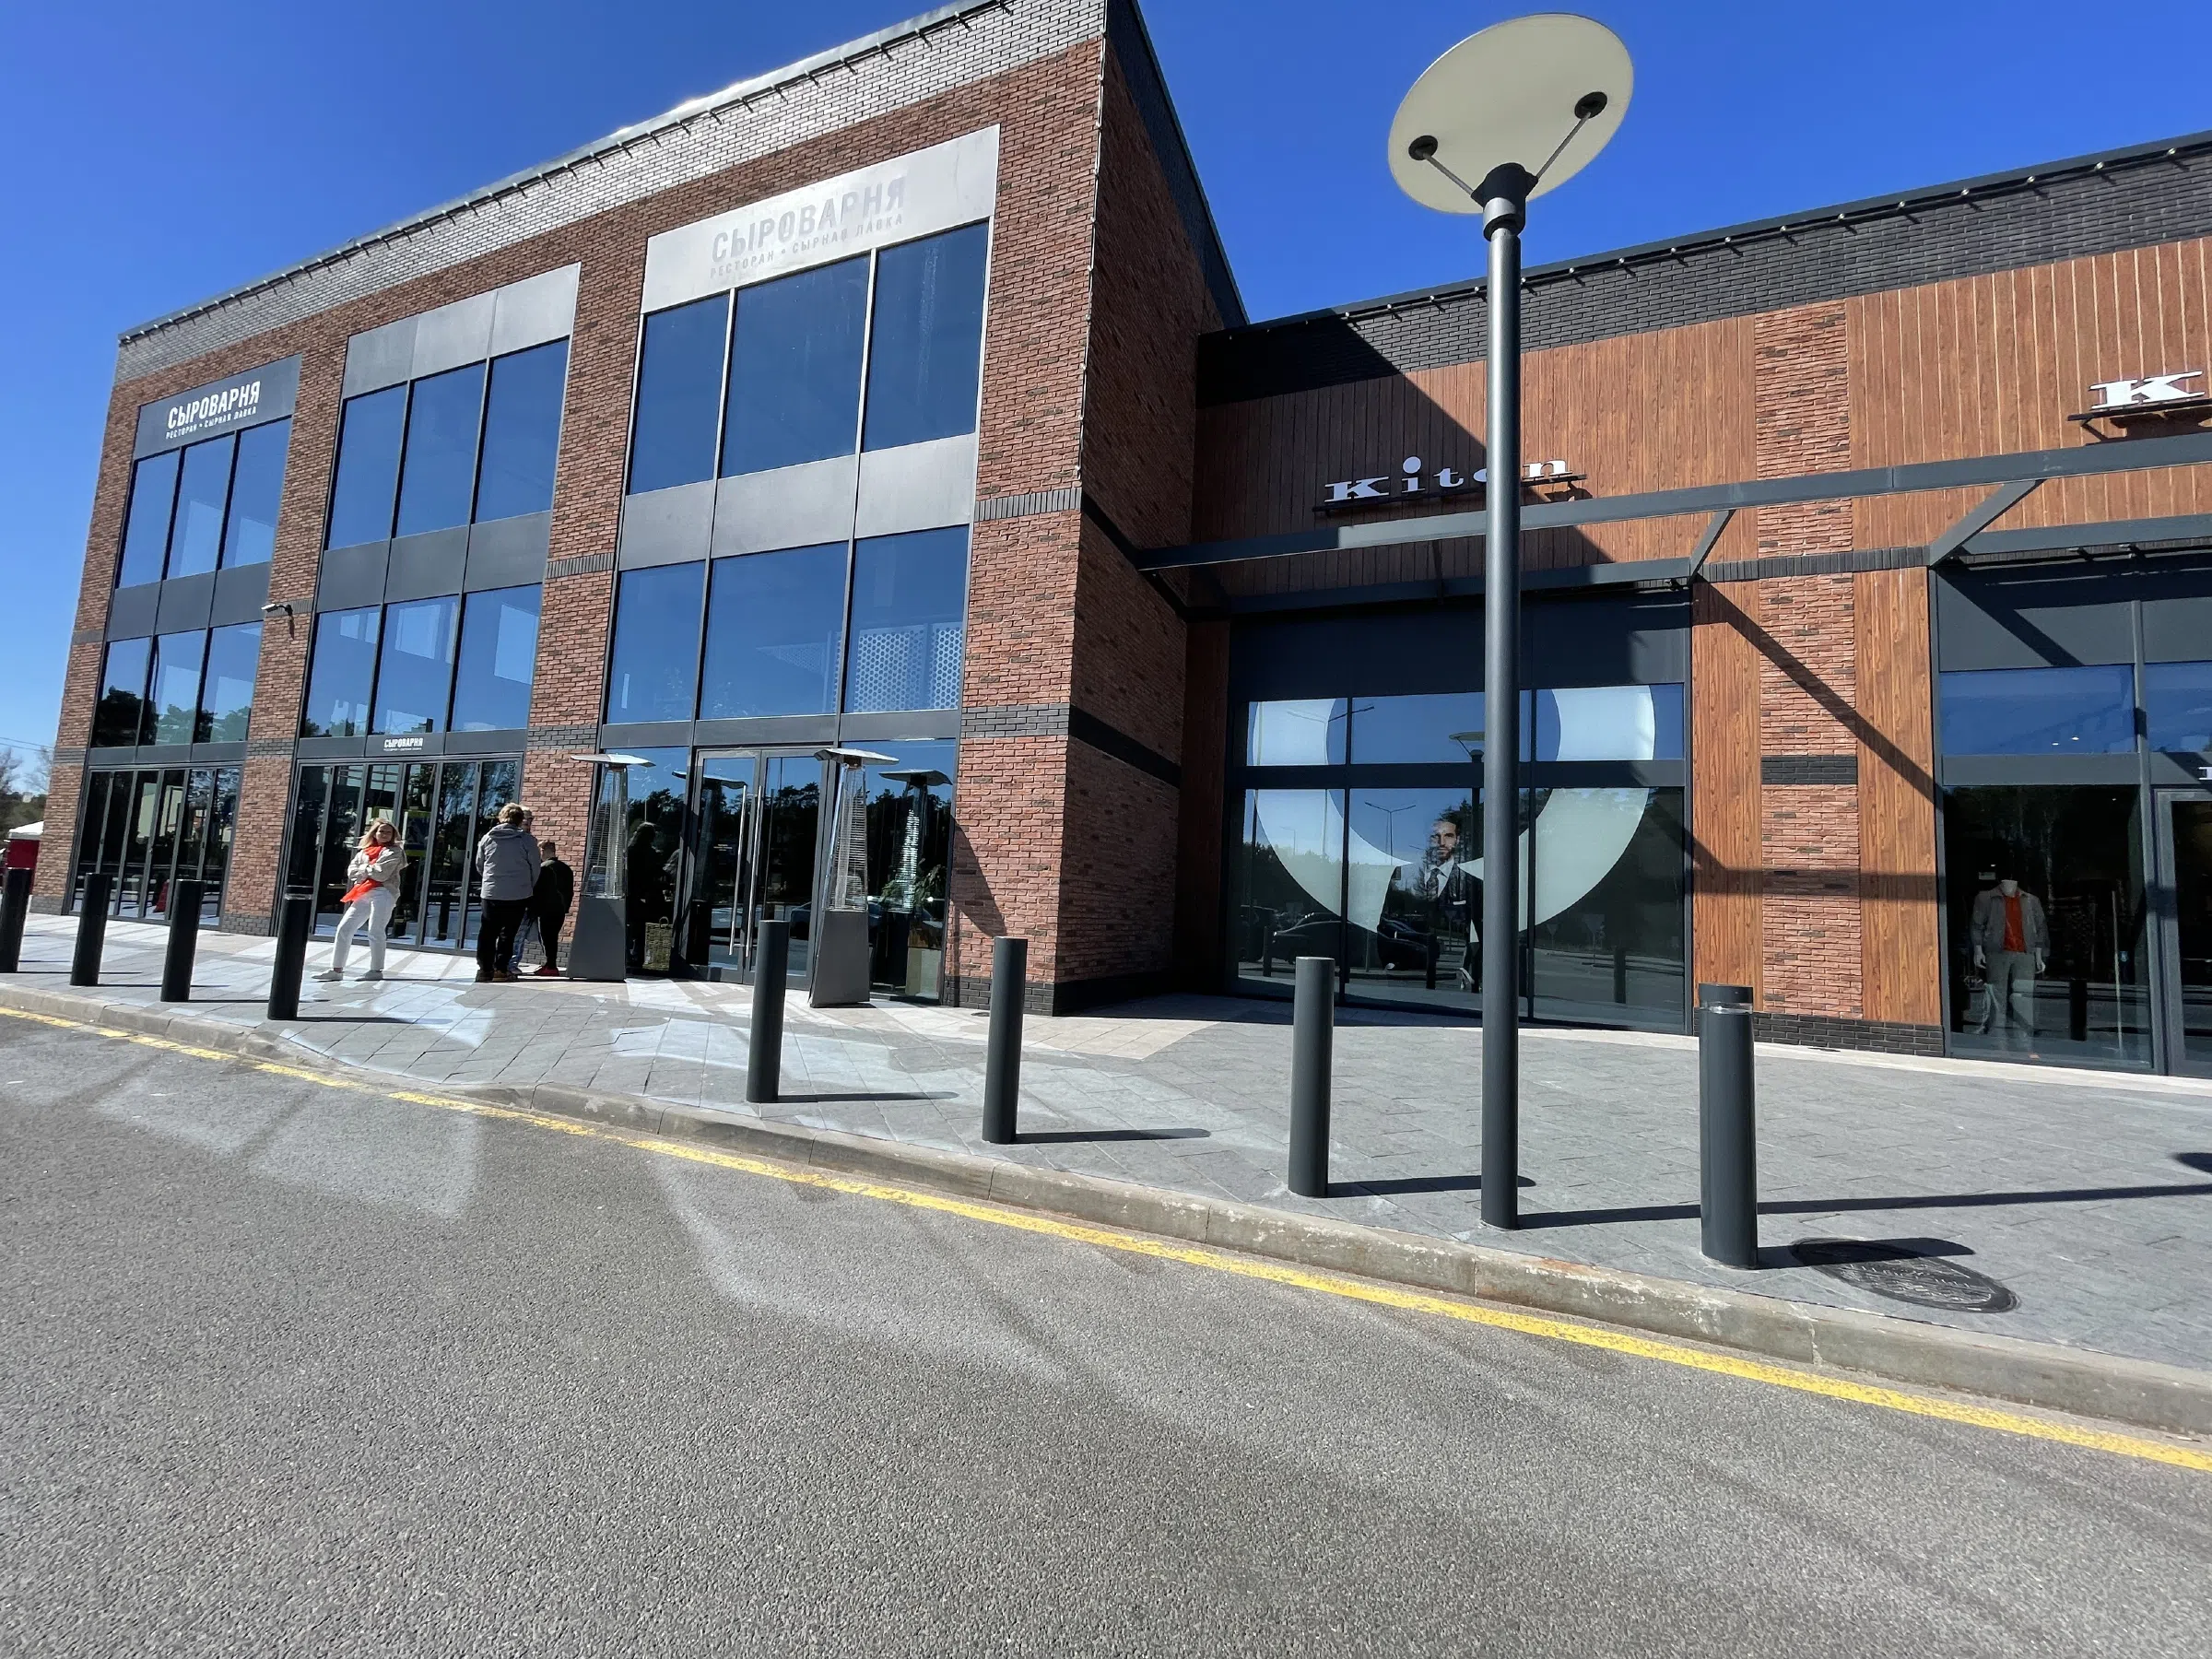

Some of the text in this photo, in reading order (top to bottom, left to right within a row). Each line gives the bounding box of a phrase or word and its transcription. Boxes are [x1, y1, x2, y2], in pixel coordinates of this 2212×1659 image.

[712, 176, 905, 263] СЫРОВАРНЯ
[711, 213, 902, 278] РЕСТОРАН СЫРНАЯ ЛАВКА
[165, 406, 256, 440] РЕСТОРАН СЫРНАЯ ЛАВКА
[167, 381, 261, 429] СЫРОВАРНЯ
[383, 737, 424, 748] СЫРОВАРНЯ
